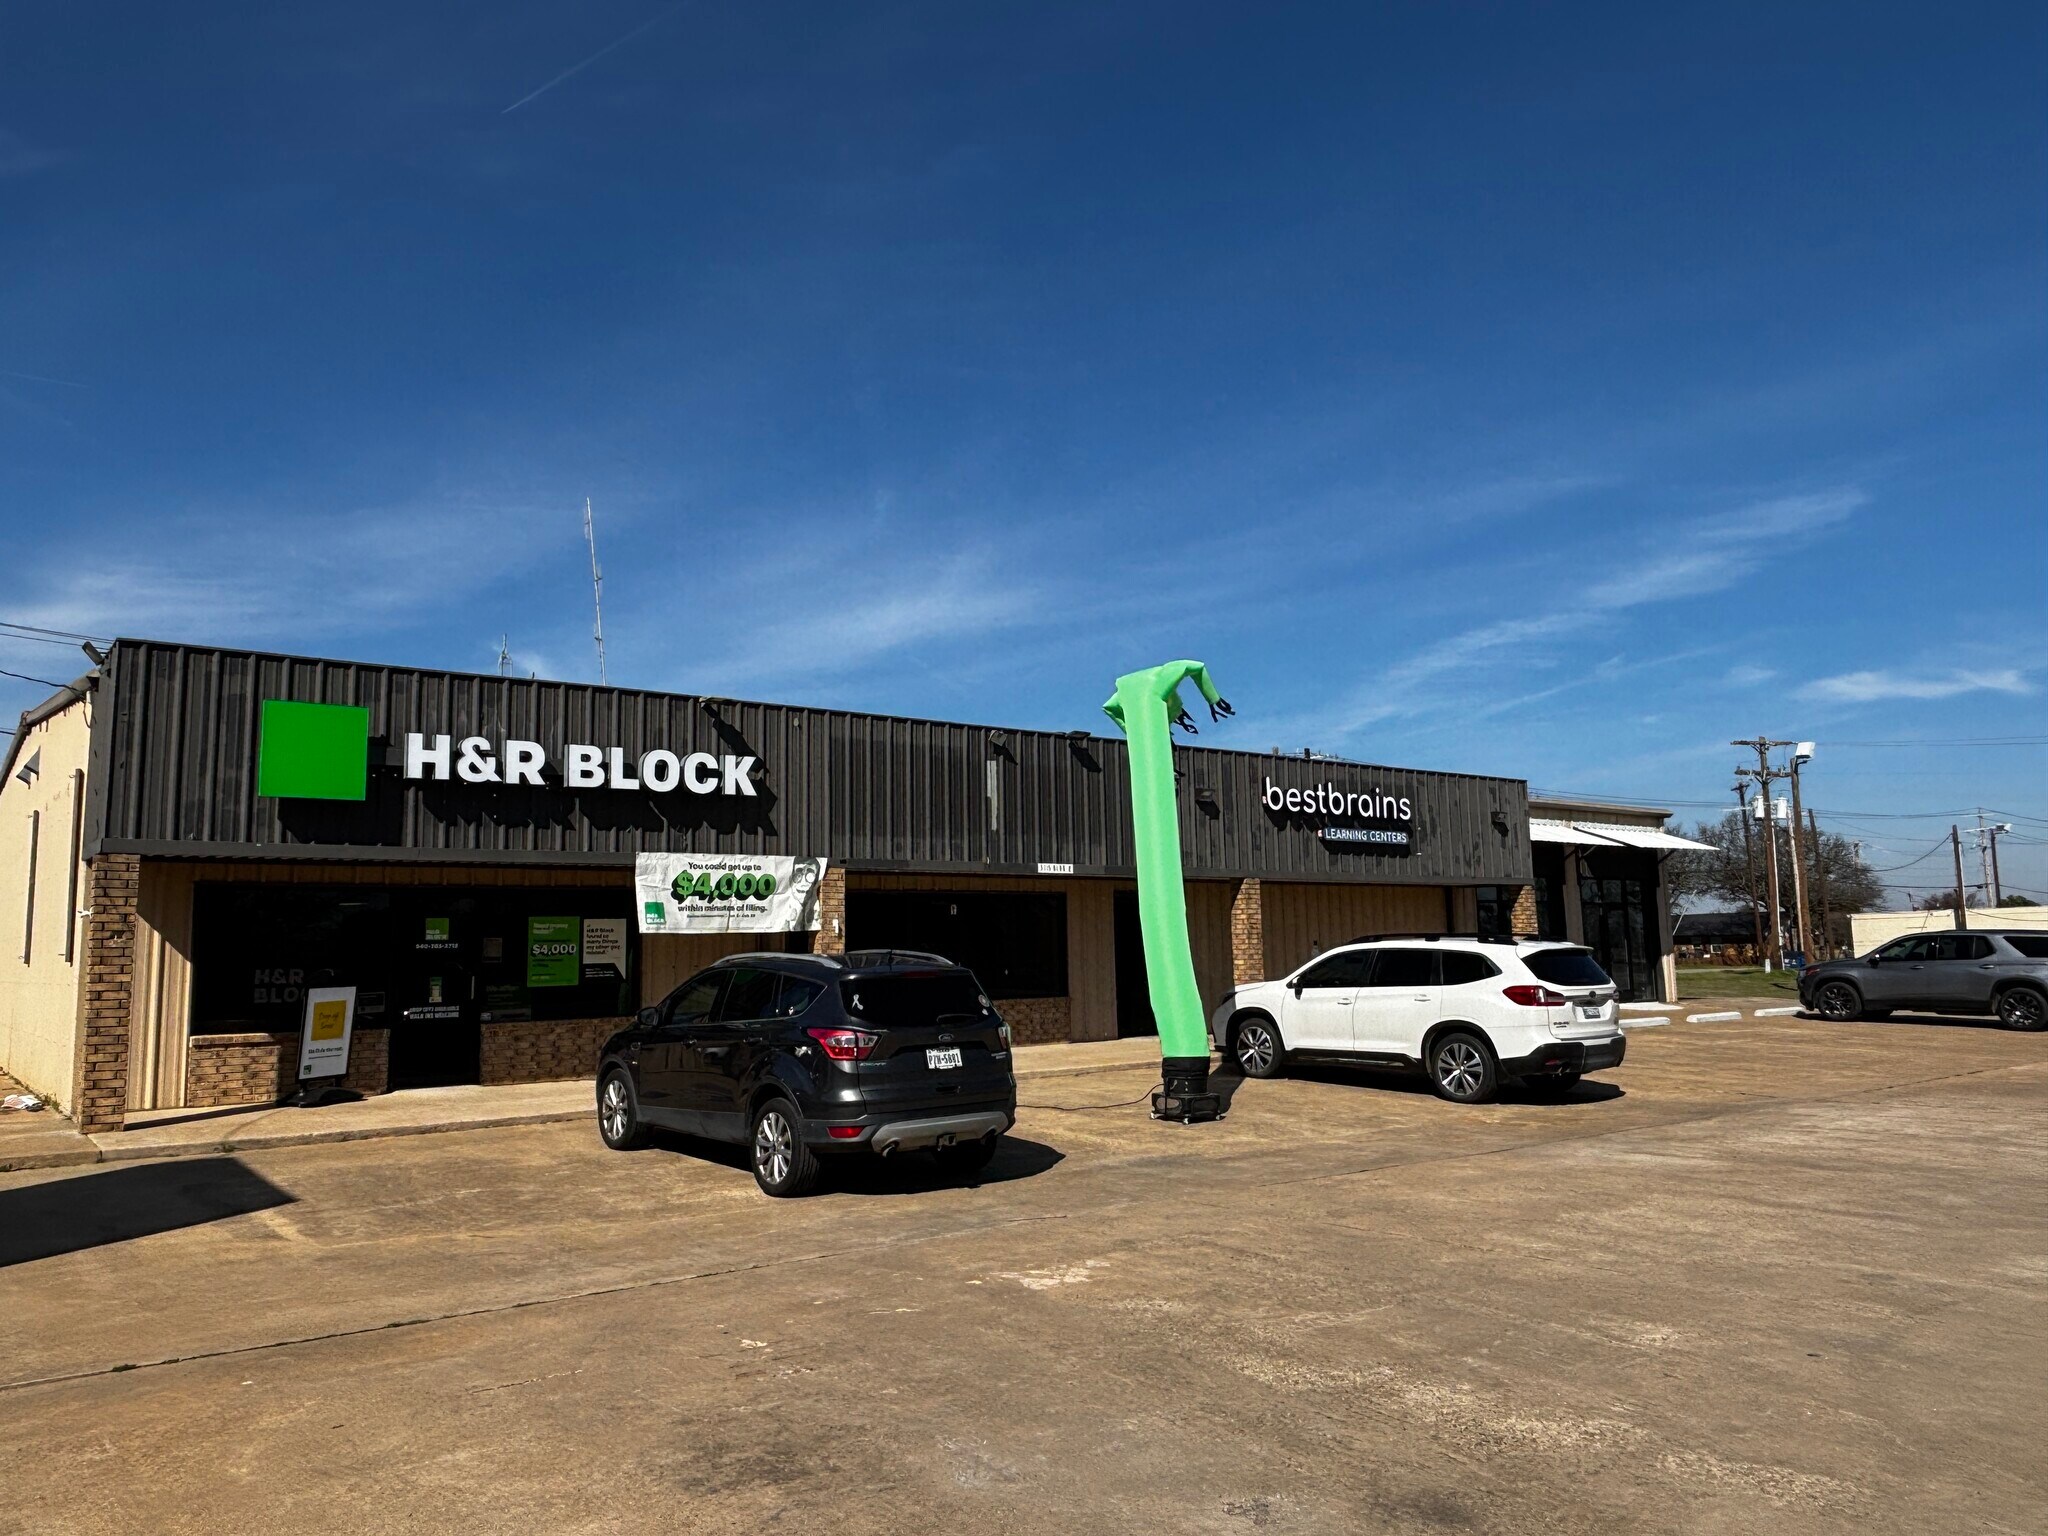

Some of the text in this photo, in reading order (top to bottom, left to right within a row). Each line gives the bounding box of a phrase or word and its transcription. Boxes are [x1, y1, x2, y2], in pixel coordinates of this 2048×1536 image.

[404, 732, 758, 796] H&R BLOCK
[1265, 776, 1411, 820] bestbrains
[1325, 828, 1407, 842] LEARNING CENTERS
[688, 861, 703, 870] You
[704, 862, 727, 871] could
[728, 864, 741, 872] get
[742, 864, 752, 872] up
[672, 870, 777, 903] $4,000
[532, 944, 577, 955] $4,000
[254, 968, 305, 985] H&R
[253, 987, 306, 1004] BLO
